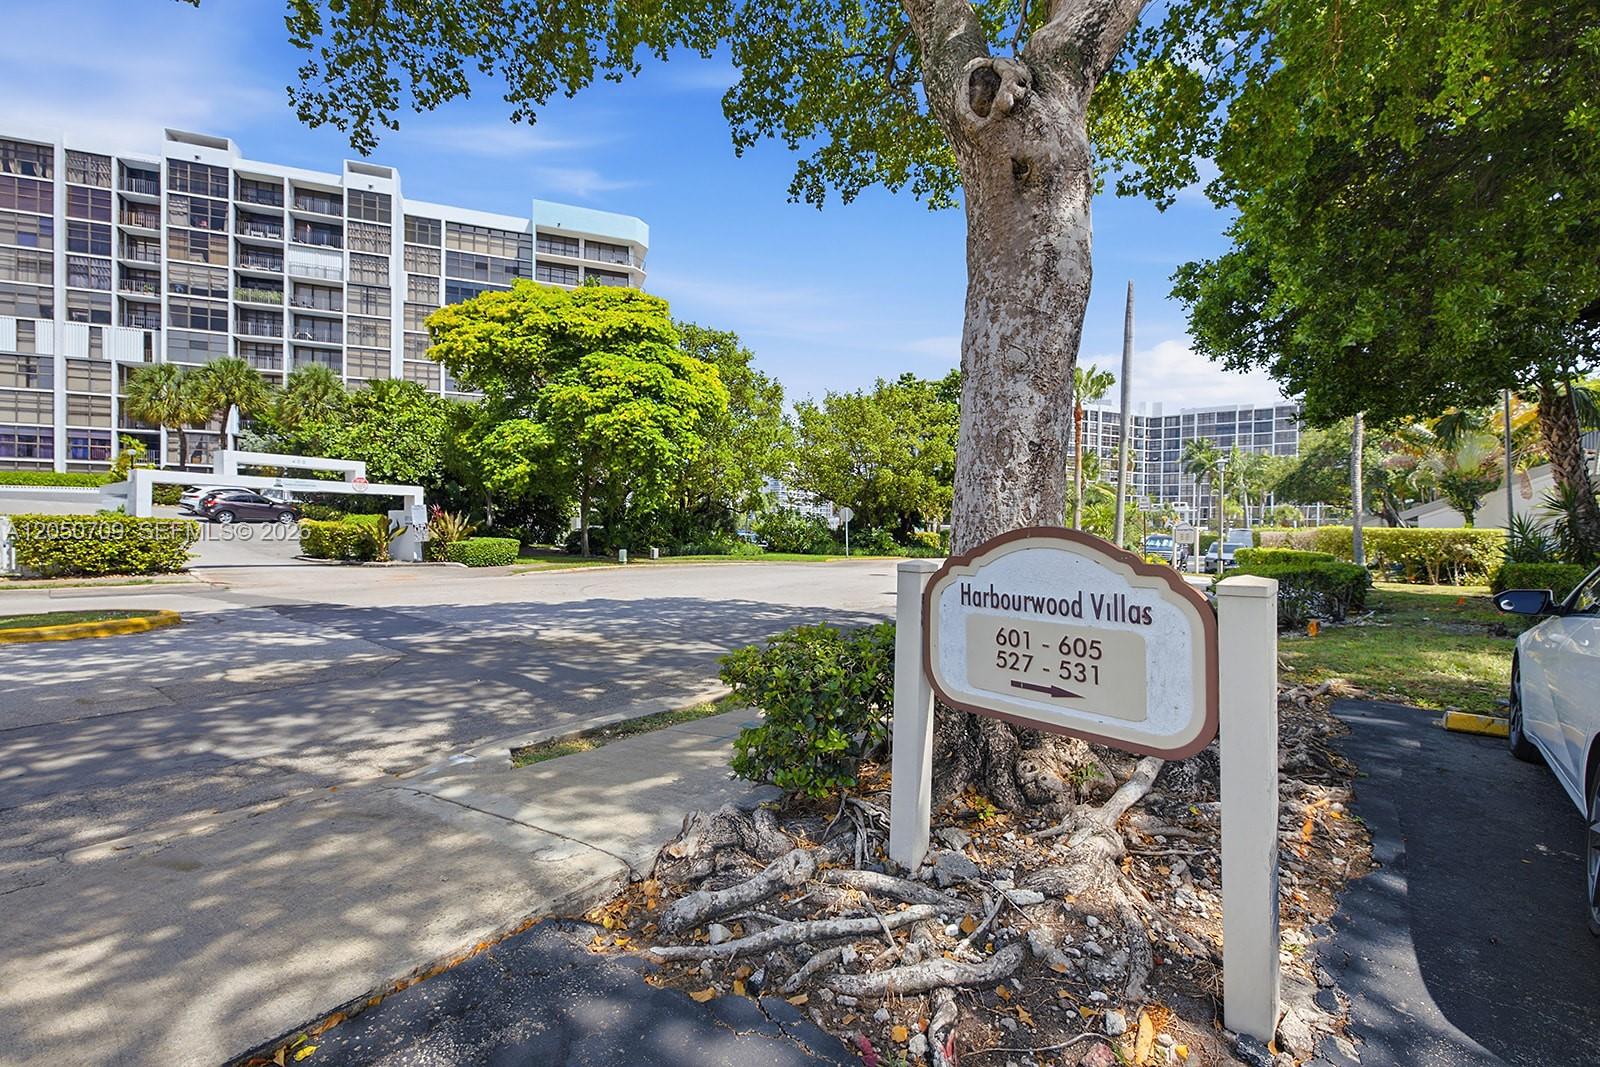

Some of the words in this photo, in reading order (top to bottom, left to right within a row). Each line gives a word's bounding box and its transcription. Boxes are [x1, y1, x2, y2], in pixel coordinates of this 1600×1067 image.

[960, 582, 1083, 619] Harbourwood
[1090, 593, 1153, 626] Villas
[995, 627, 1031, 650] 601
[1058, 635, 1102, 661] 605
[995, 650, 1034, 673] 527
[1058, 660, 1101, 685] 531
